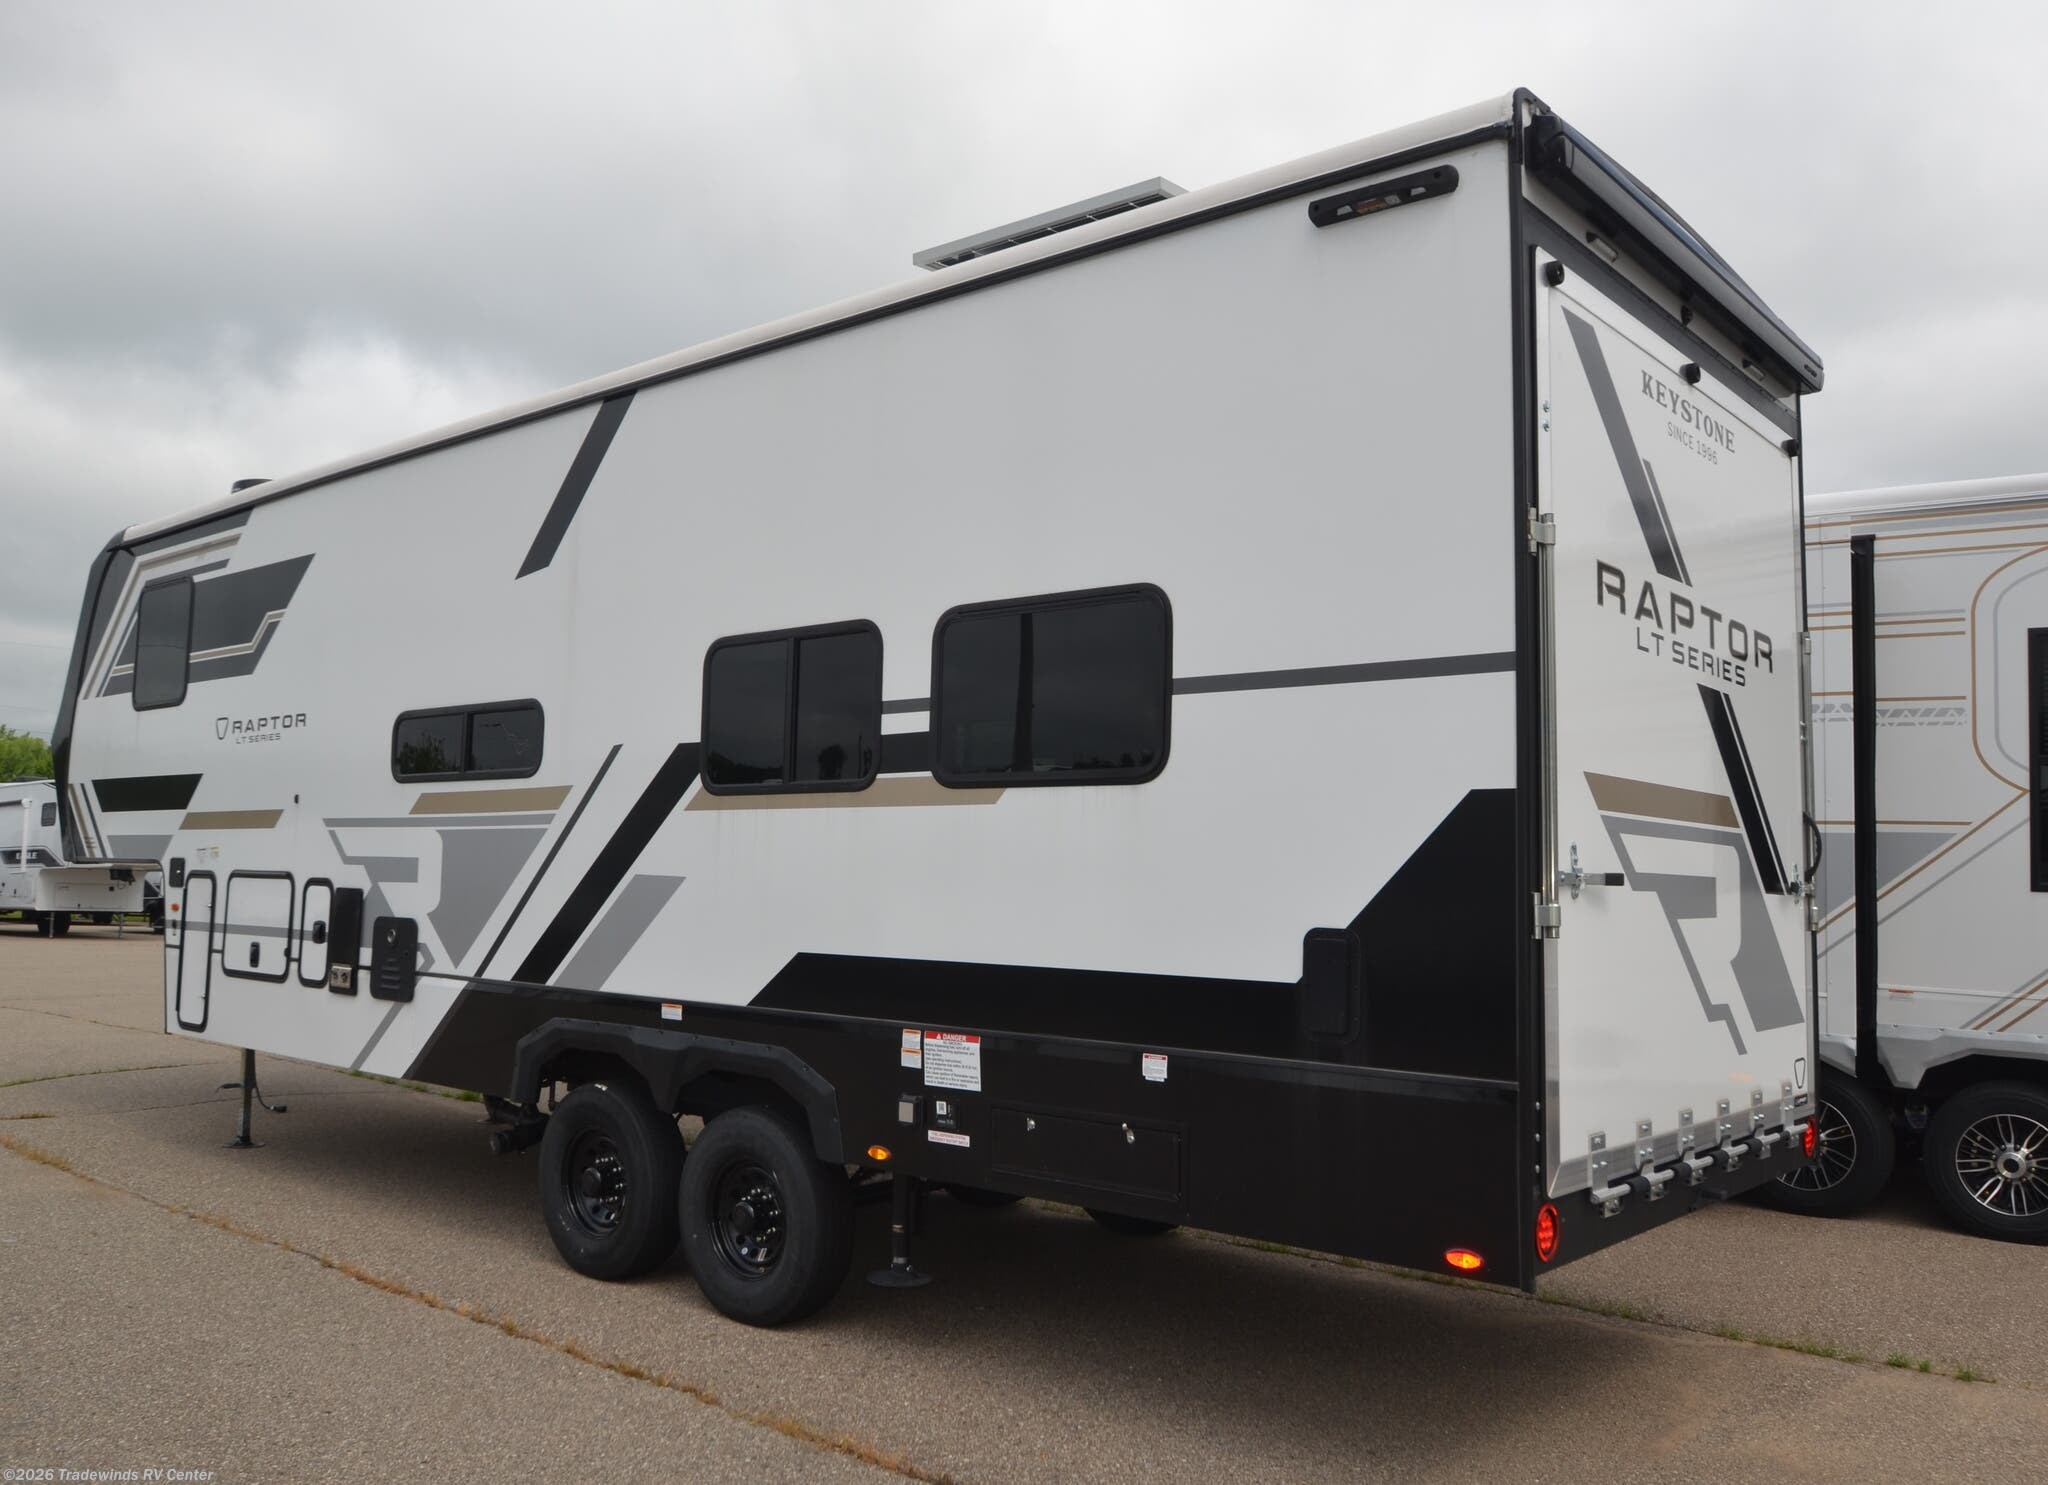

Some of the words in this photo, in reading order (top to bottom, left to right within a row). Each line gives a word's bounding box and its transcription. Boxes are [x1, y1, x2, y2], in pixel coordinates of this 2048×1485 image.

[1641, 369, 1735, 454] KEYSTONE
[1667, 421, 1694, 450] SINCE
[1696, 440, 1718, 465] 1996
[1597, 559, 1773, 673] RAPTOR
[1636, 626, 1664, 657] LT
[1672, 640, 1746, 687] SERIES
[232, 713, 306, 734] RAPTOR
[248, 732, 281, 743] SERIES
[942, 1033, 967, 1043] DANGER
